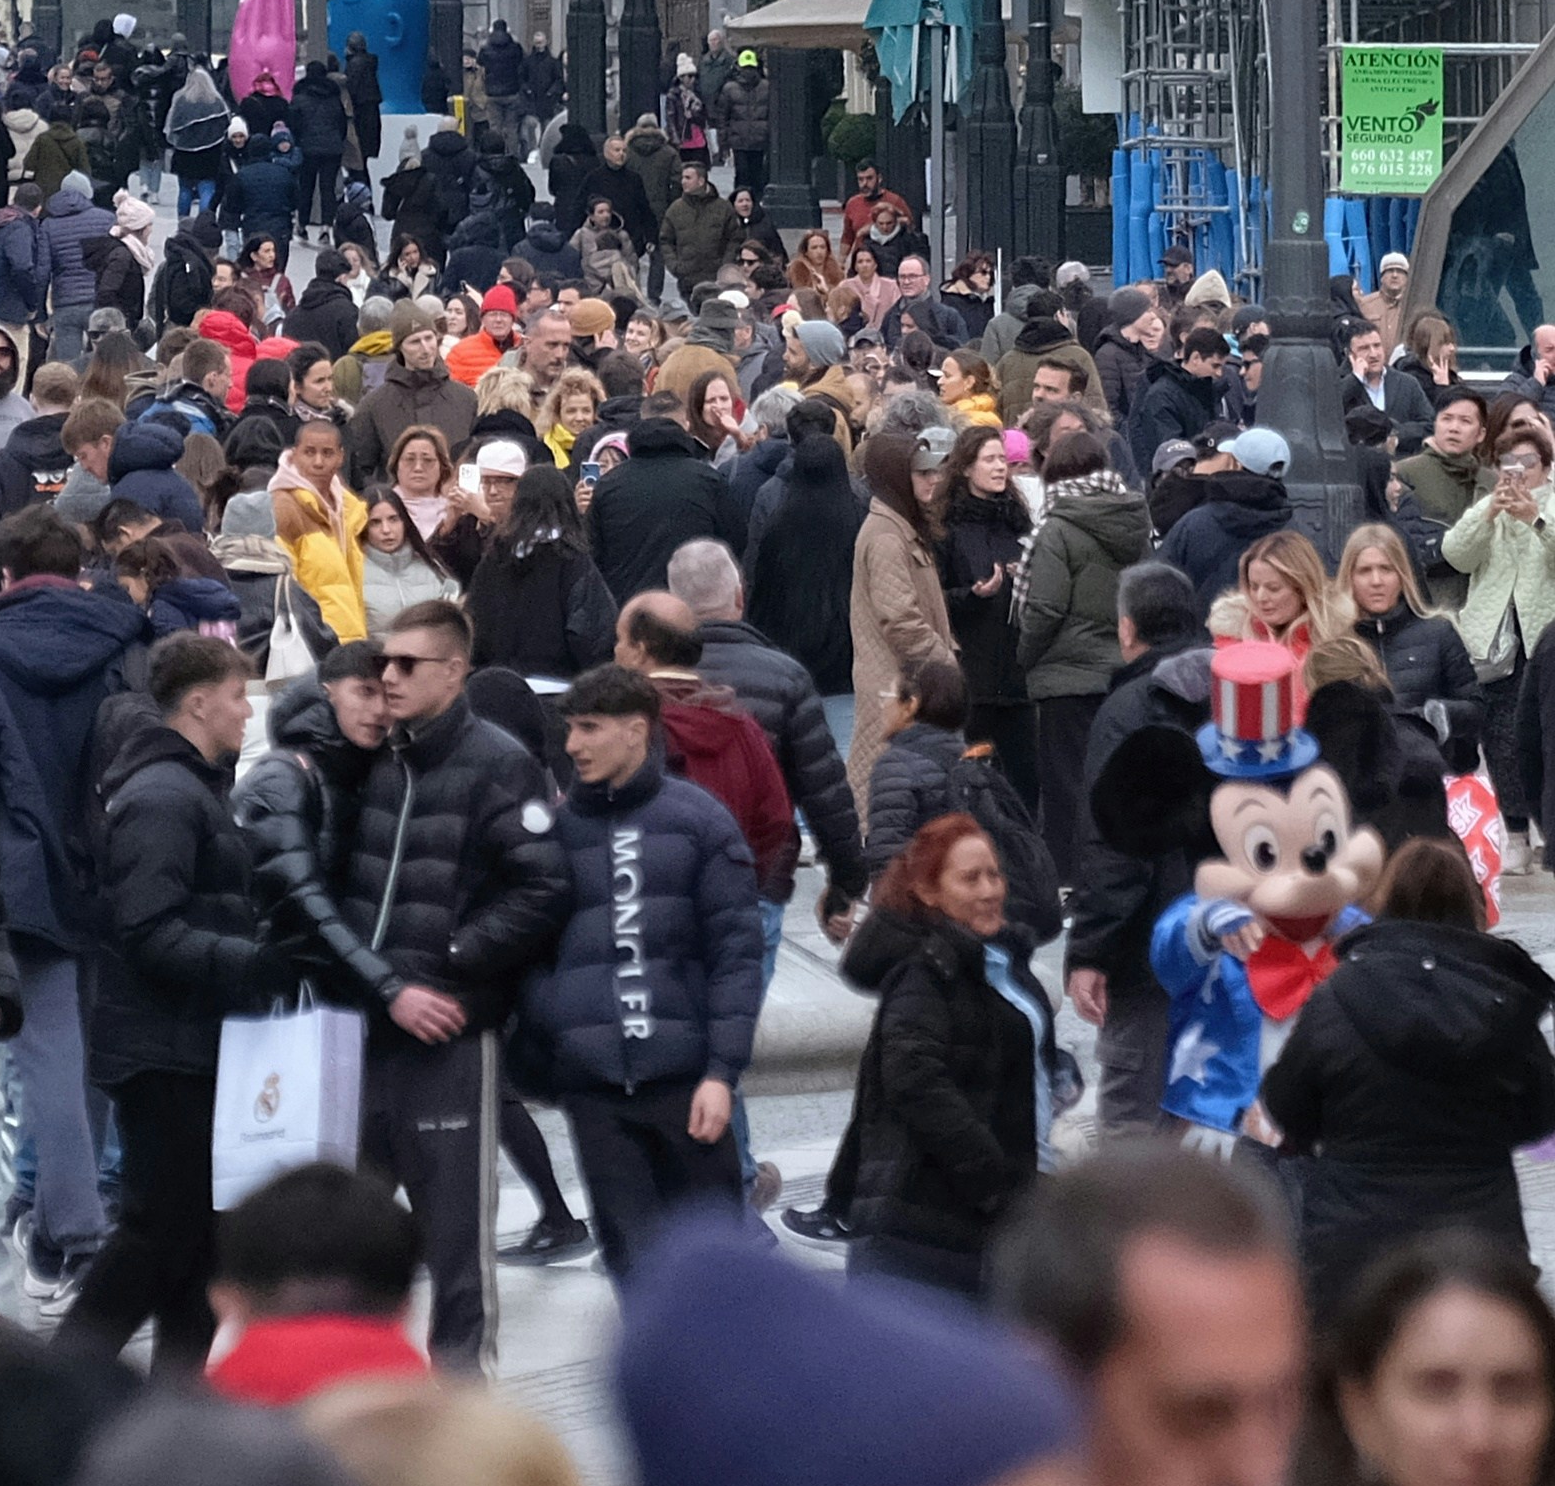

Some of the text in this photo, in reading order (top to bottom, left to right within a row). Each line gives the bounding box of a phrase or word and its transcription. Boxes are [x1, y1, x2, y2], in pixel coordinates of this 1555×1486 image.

[1345, 50, 1439, 68] ATENCIÓN
[1346, 115, 1414, 133] VENTO
[1346, 132, 1414, 144] SEGURIDAD
[1351, 149, 1433, 162] 660 632 487
[1351, 163, 1433, 176] 676 015 228
